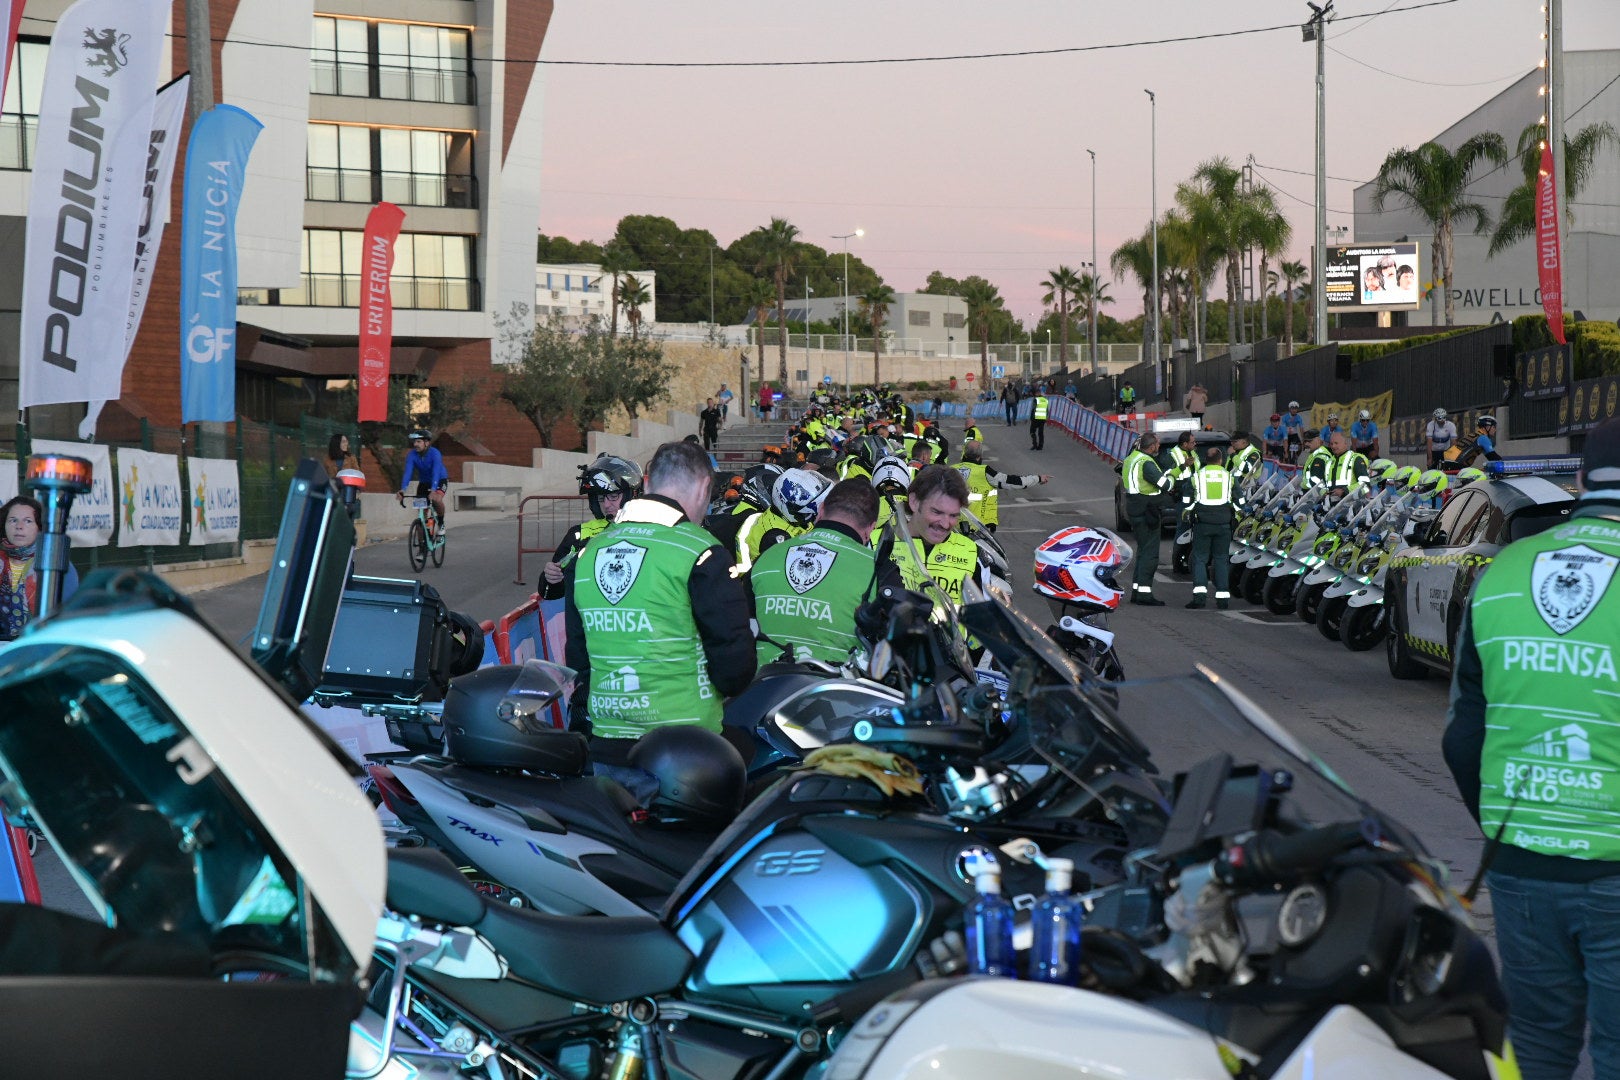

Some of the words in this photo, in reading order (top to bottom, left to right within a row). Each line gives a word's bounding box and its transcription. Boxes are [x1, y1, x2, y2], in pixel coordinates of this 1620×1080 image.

[42, 75, 110, 373] PODIUM
[91, 166, 114, 292] PODIUMBIKE.ES
[201, 269, 222, 298] LA
[367, 235, 389, 336] CRITERIUM
[583, 611, 654, 633] PRENSA
[765, 596, 833, 624] PRENSA
[1503, 640, 1618, 682] PRENSA
[591, 695, 650, 709] BODEGAS
[1504, 762, 1603, 789] BODEGAS
[754, 850, 825, 877] GS
